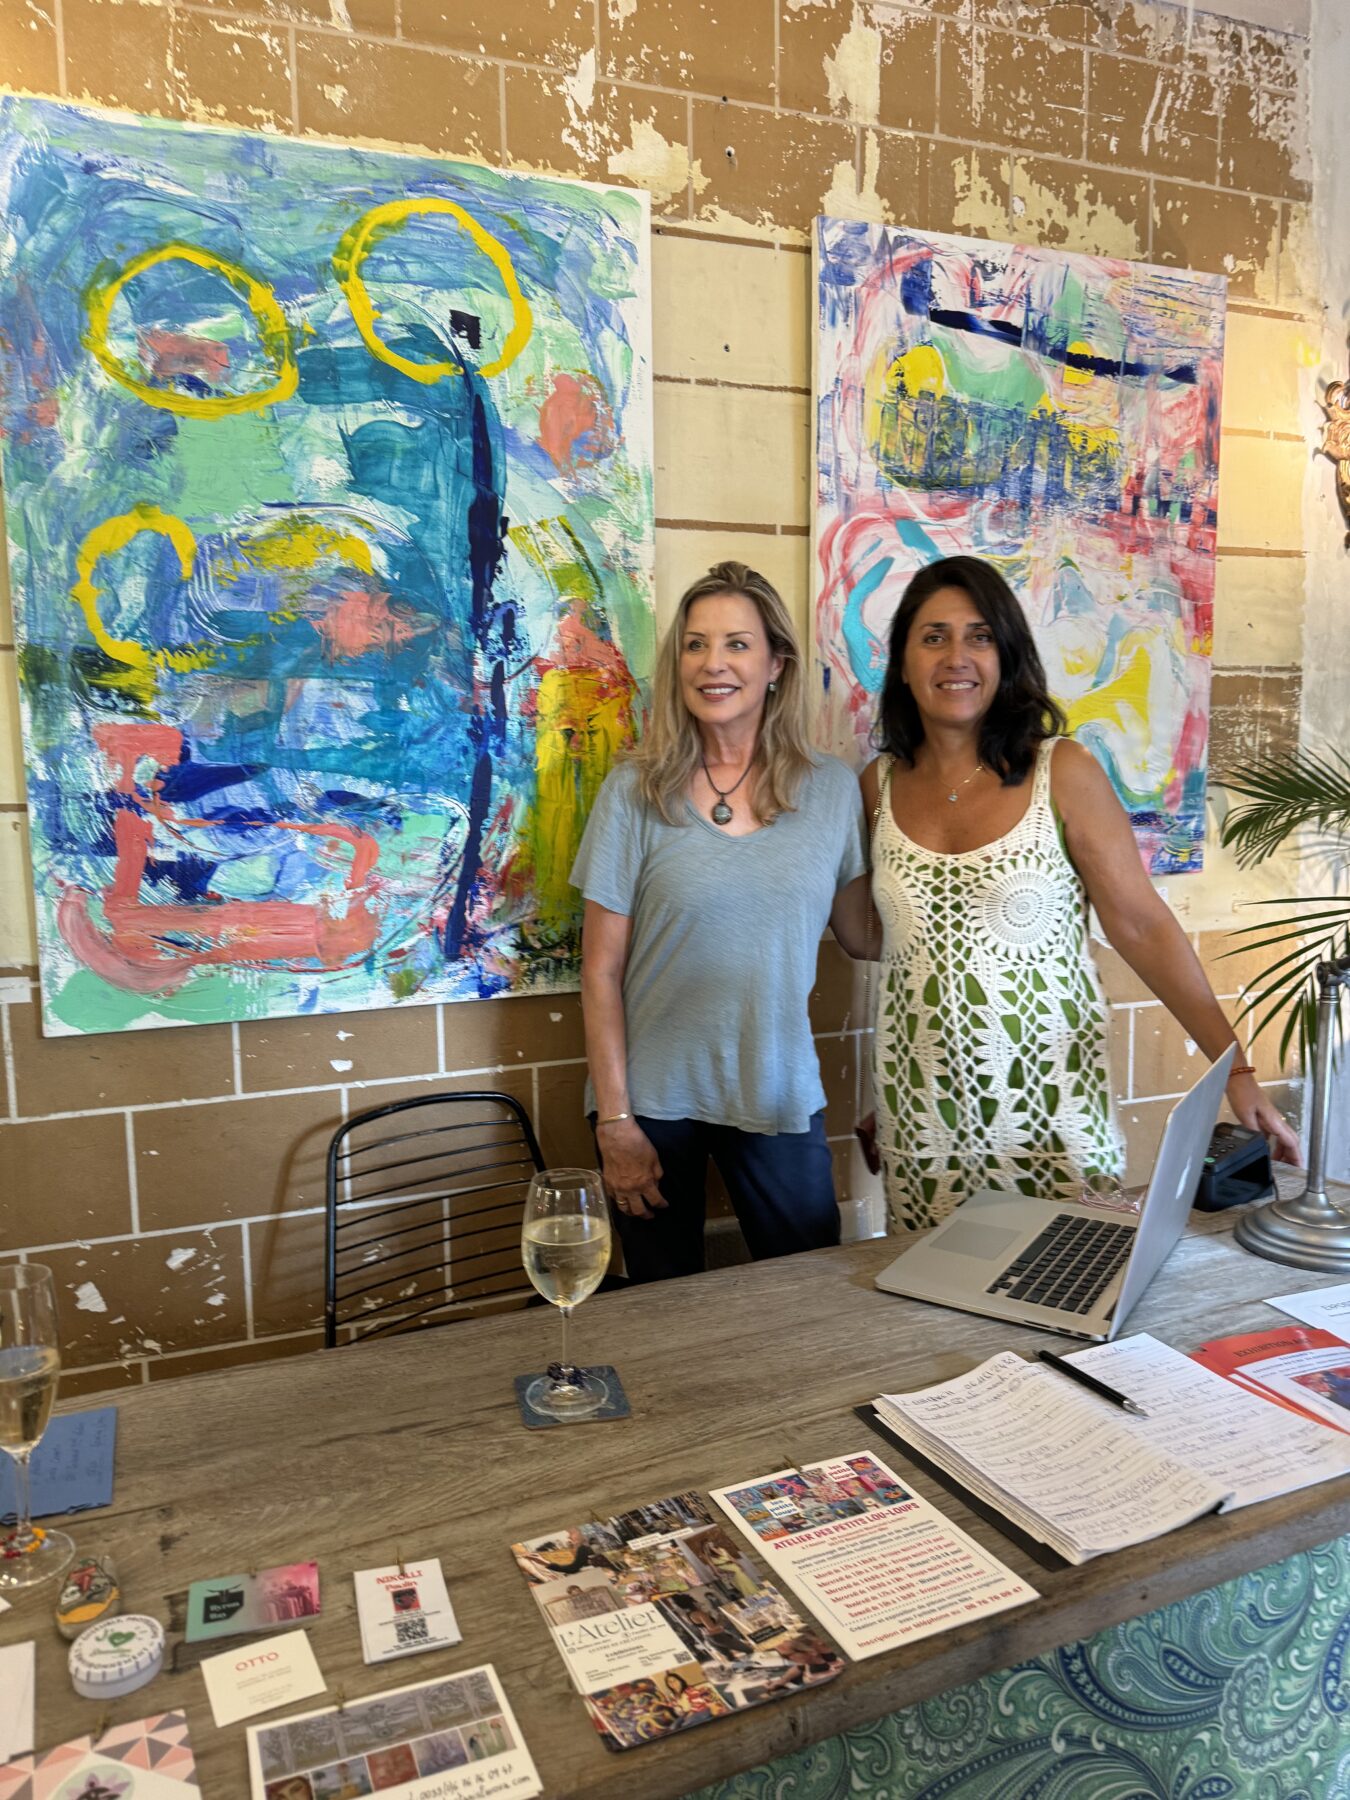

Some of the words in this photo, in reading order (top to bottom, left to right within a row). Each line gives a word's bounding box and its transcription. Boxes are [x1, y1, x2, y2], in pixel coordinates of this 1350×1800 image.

[769, 1502, 793, 1513] petits
[774, 1534, 815, 1550] ATELIER
[813, 1528, 834, 1538] DES
[832, 1518, 868, 1532] PETITS
[865, 1503, 920, 1522] LOU-LOUPS
[560, 1609, 656, 1648] L'Atelier
[857, 1631, 900, 1648] Inscription
[899, 1626, 912, 1634] par
[912, 1613, 950, 1628] téléphone
[235, 1652, 279, 1671] OTTO
